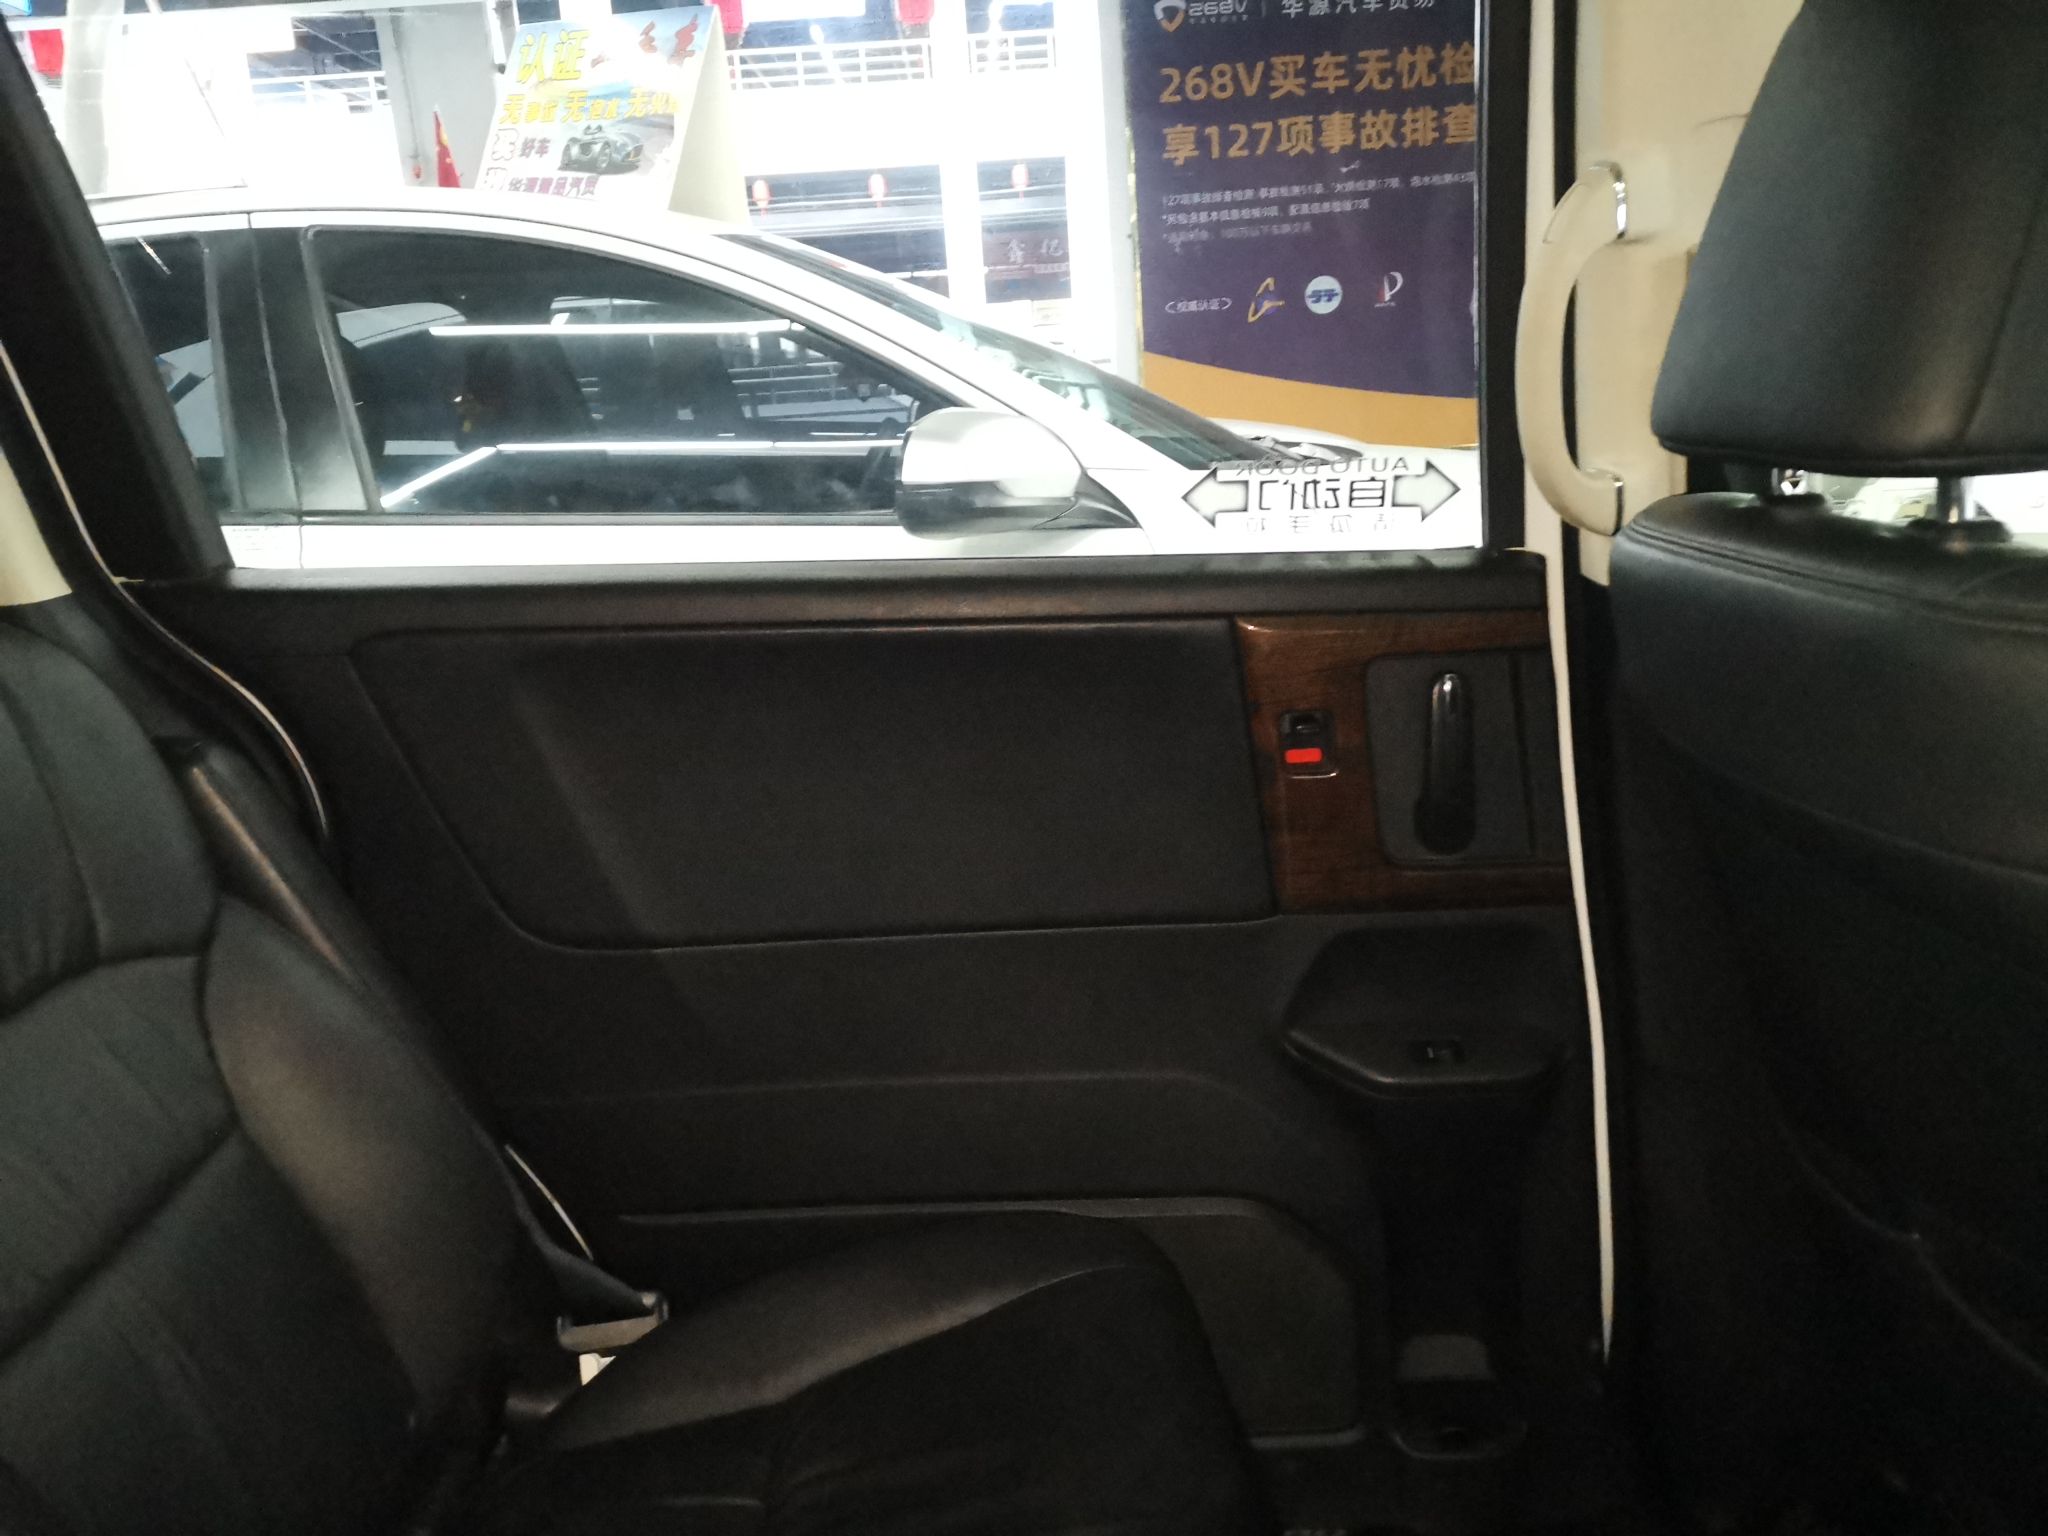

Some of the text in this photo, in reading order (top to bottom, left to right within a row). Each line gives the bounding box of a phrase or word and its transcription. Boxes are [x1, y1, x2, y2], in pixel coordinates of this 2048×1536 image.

[516, 28, 590, 83] 认证
[1163, 102, 1475, 167] 享127项事故排查
